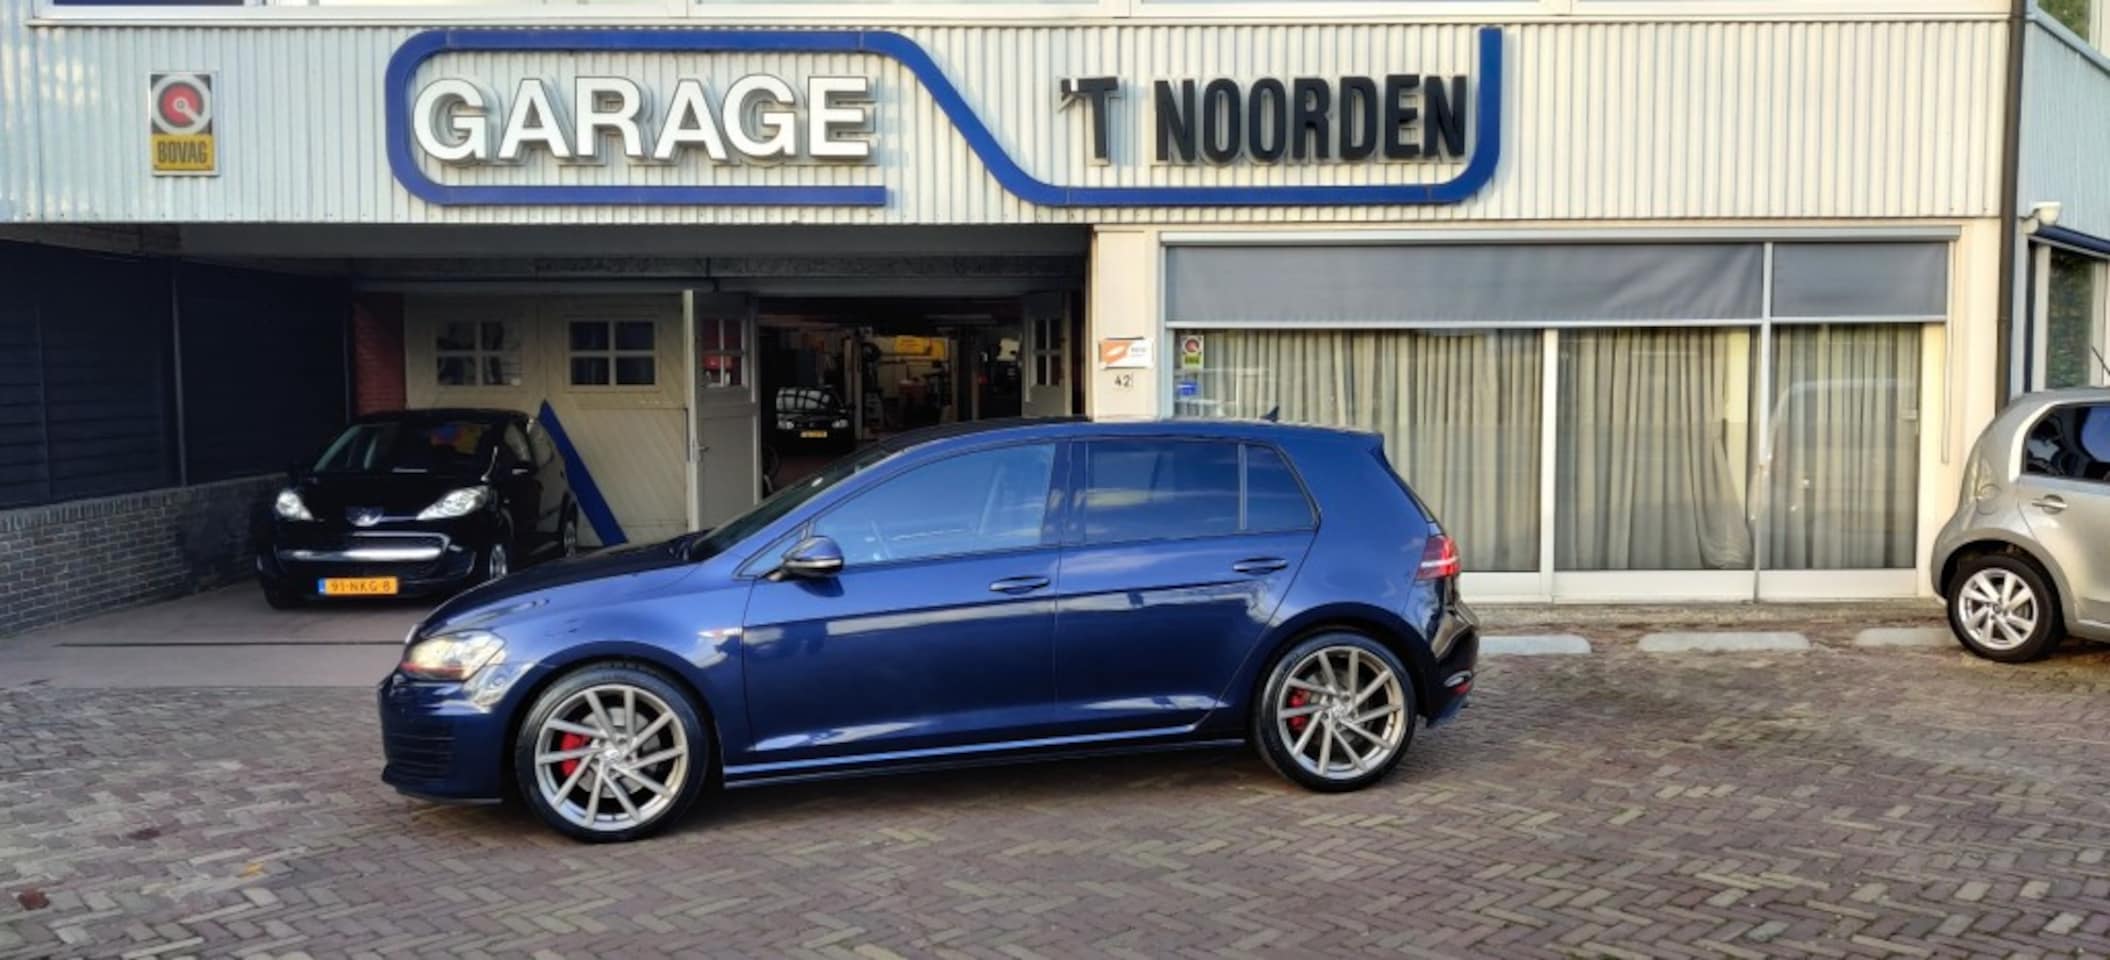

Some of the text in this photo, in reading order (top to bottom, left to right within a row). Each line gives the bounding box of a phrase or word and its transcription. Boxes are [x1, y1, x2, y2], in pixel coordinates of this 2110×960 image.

[413, 74, 869, 161] GARAGE
[1154, 74, 1468, 162] NOORDEN
[157, 140, 208, 164] BOVAG
